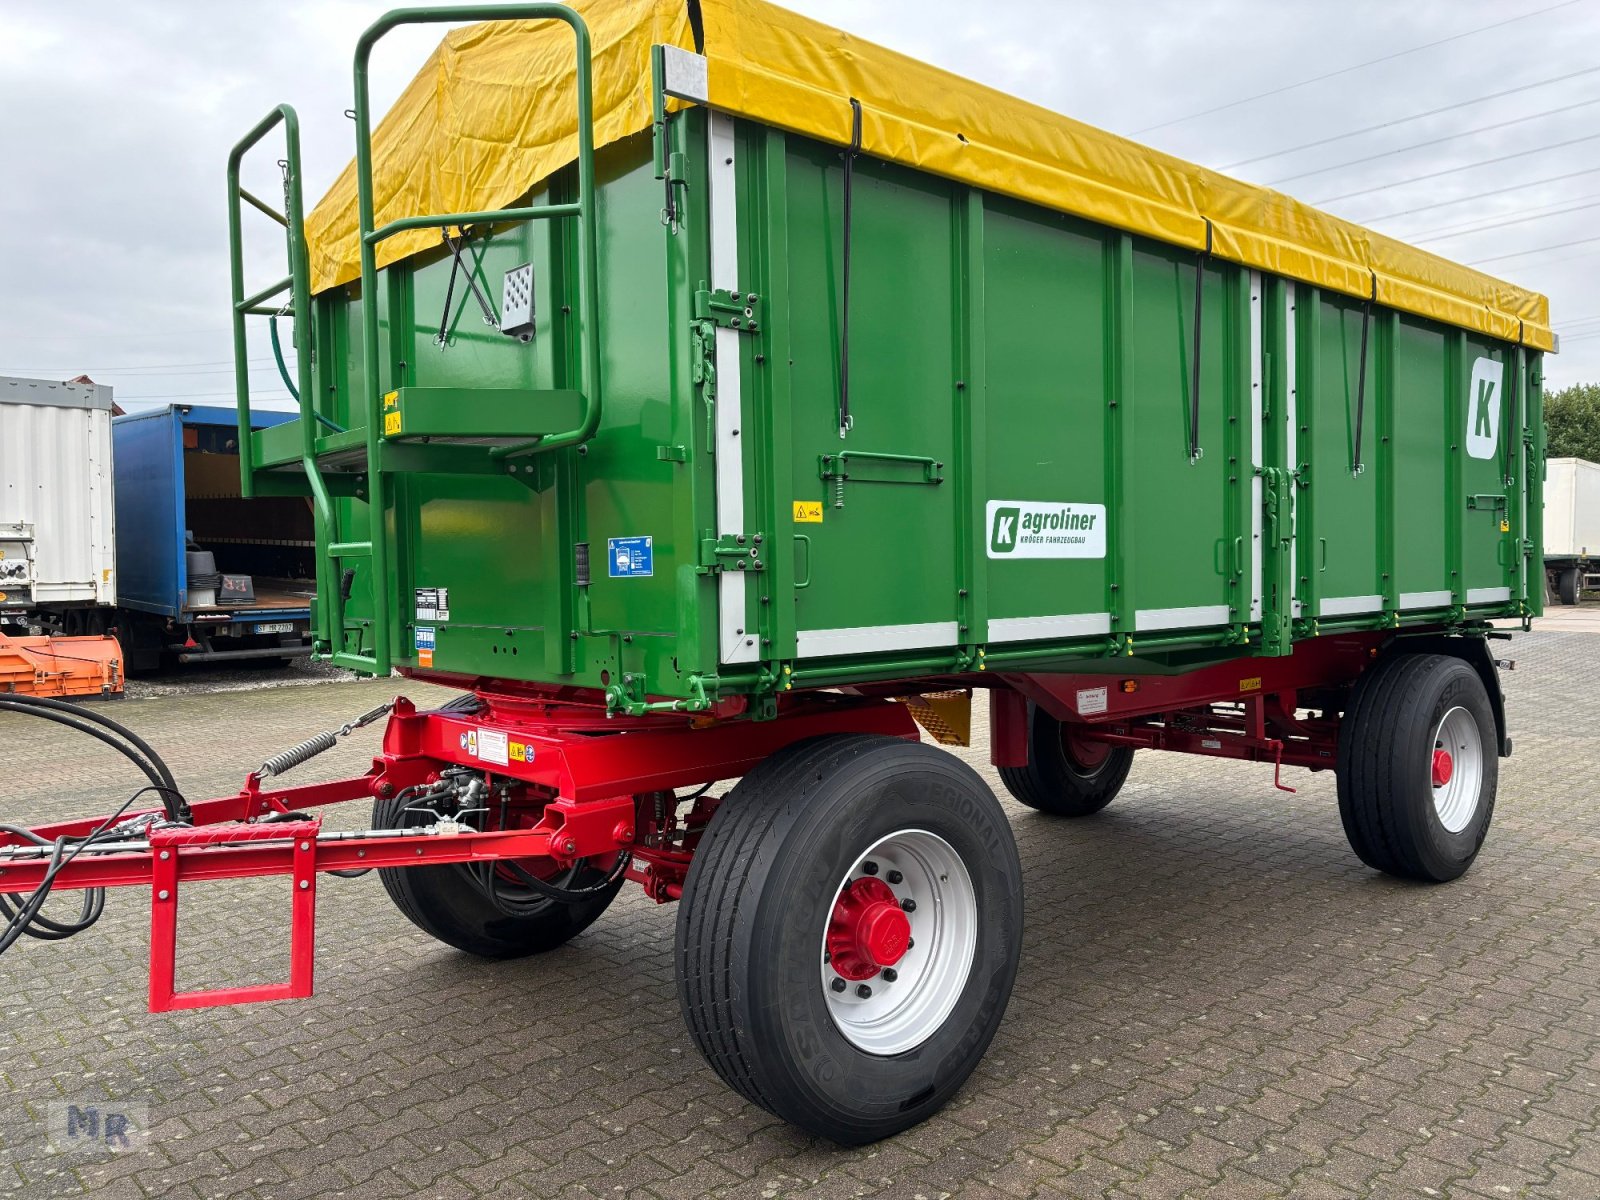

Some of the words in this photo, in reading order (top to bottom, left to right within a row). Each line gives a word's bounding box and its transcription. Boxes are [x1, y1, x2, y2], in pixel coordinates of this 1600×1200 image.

[1475, 378, 1496, 438] K
[997, 516, 1015, 544] K
[1022, 507, 1097, 535] agroliner
[1020, 535, 1044, 544] KRÖGER
[1045, 536, 1086, 544] FAHRZEUGBAU
